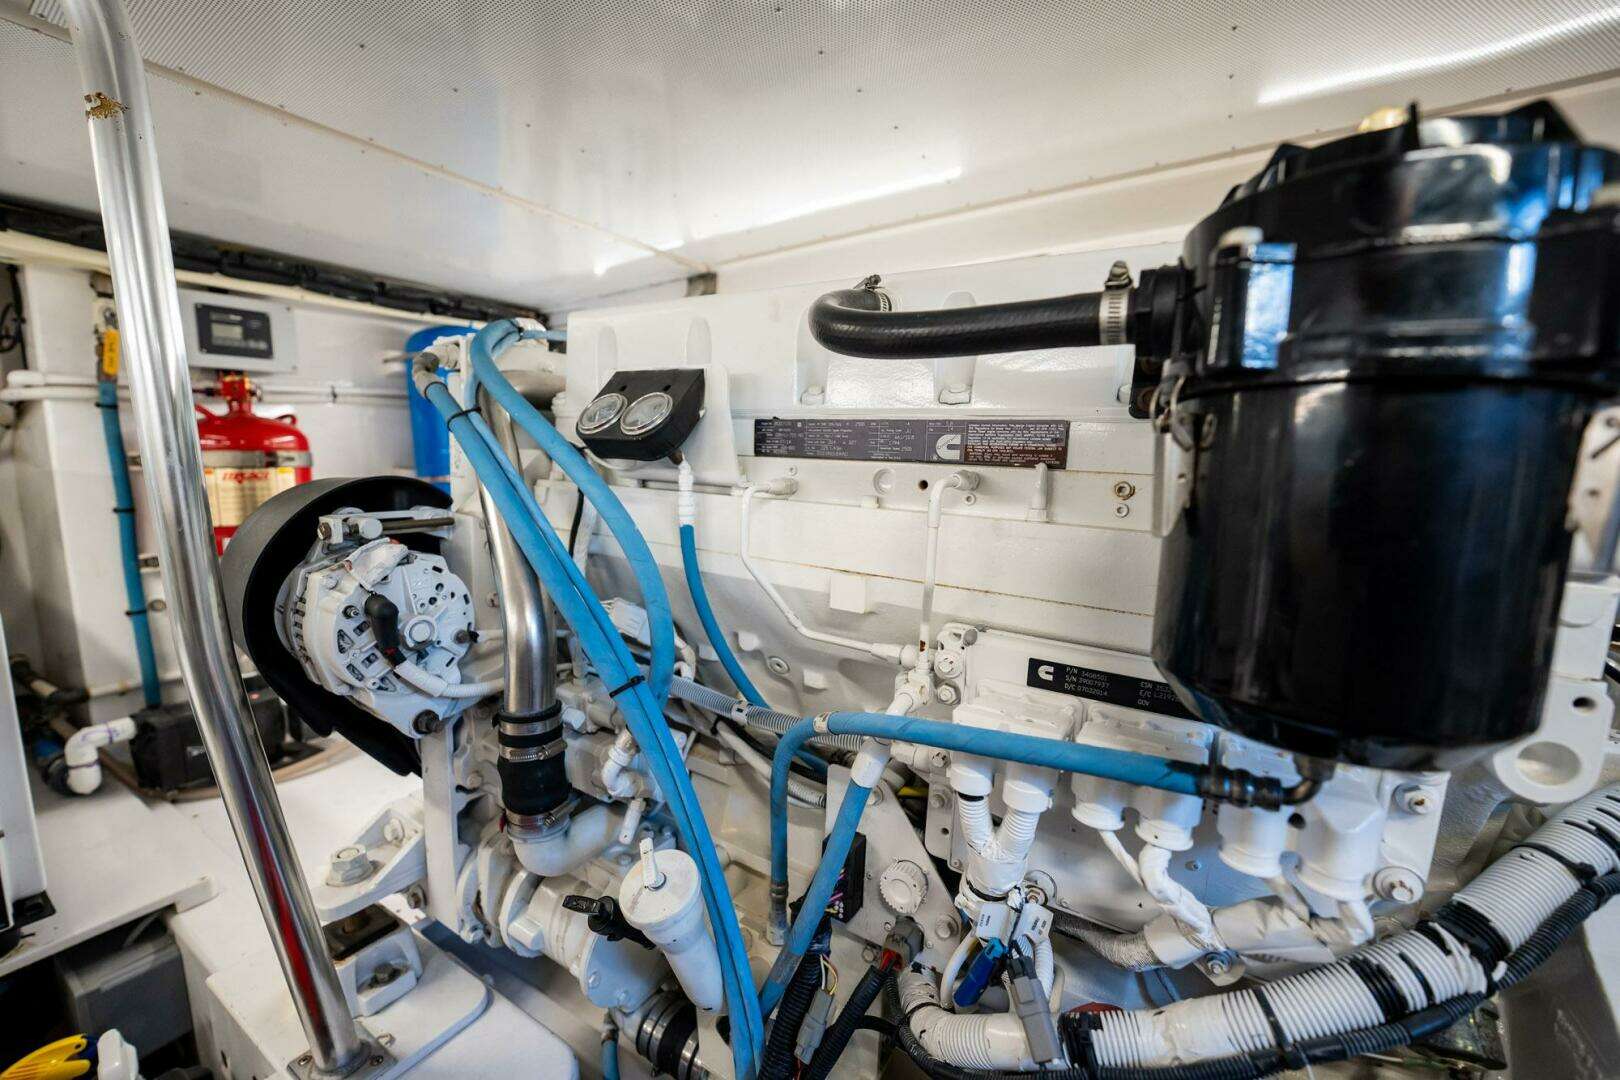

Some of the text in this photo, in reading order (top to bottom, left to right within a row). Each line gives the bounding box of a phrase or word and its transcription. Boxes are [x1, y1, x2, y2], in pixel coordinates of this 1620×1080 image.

[1066, 666, 1078, 675] P/N
[1065, 675, 1077, 683] S/N
[1064, 683, 1076, 692] D/C
